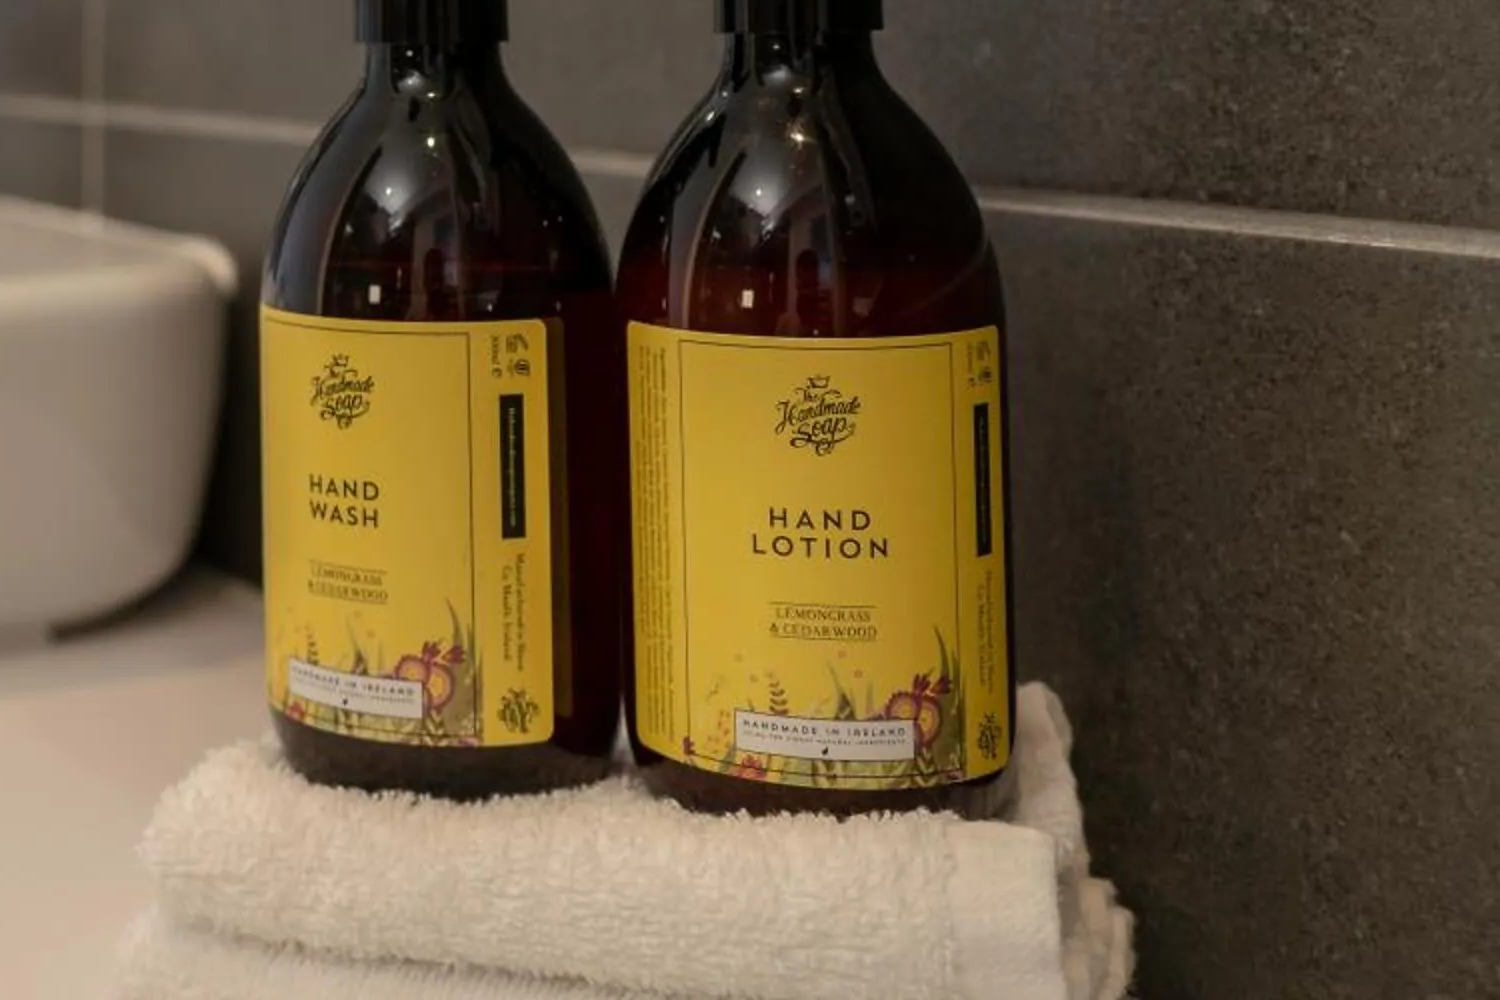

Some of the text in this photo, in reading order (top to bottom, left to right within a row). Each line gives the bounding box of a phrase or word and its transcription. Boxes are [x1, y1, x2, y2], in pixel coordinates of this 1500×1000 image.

[775, 393, 861, 435] Handmade
[790, 417, 856, 448] Soap
[308, 474, 380, 501] HAND
[308, 501, 380, 529] WASH
[768, 507, 872, 531] HAND
[751, 533, 889, 559] LOTION
[776, 607, 871, 622] LEMONGRASS
[783, 622, 878, 639] CEDARWOOD
[742, 719, 907, 738] HANDMADE IN IRELAND
